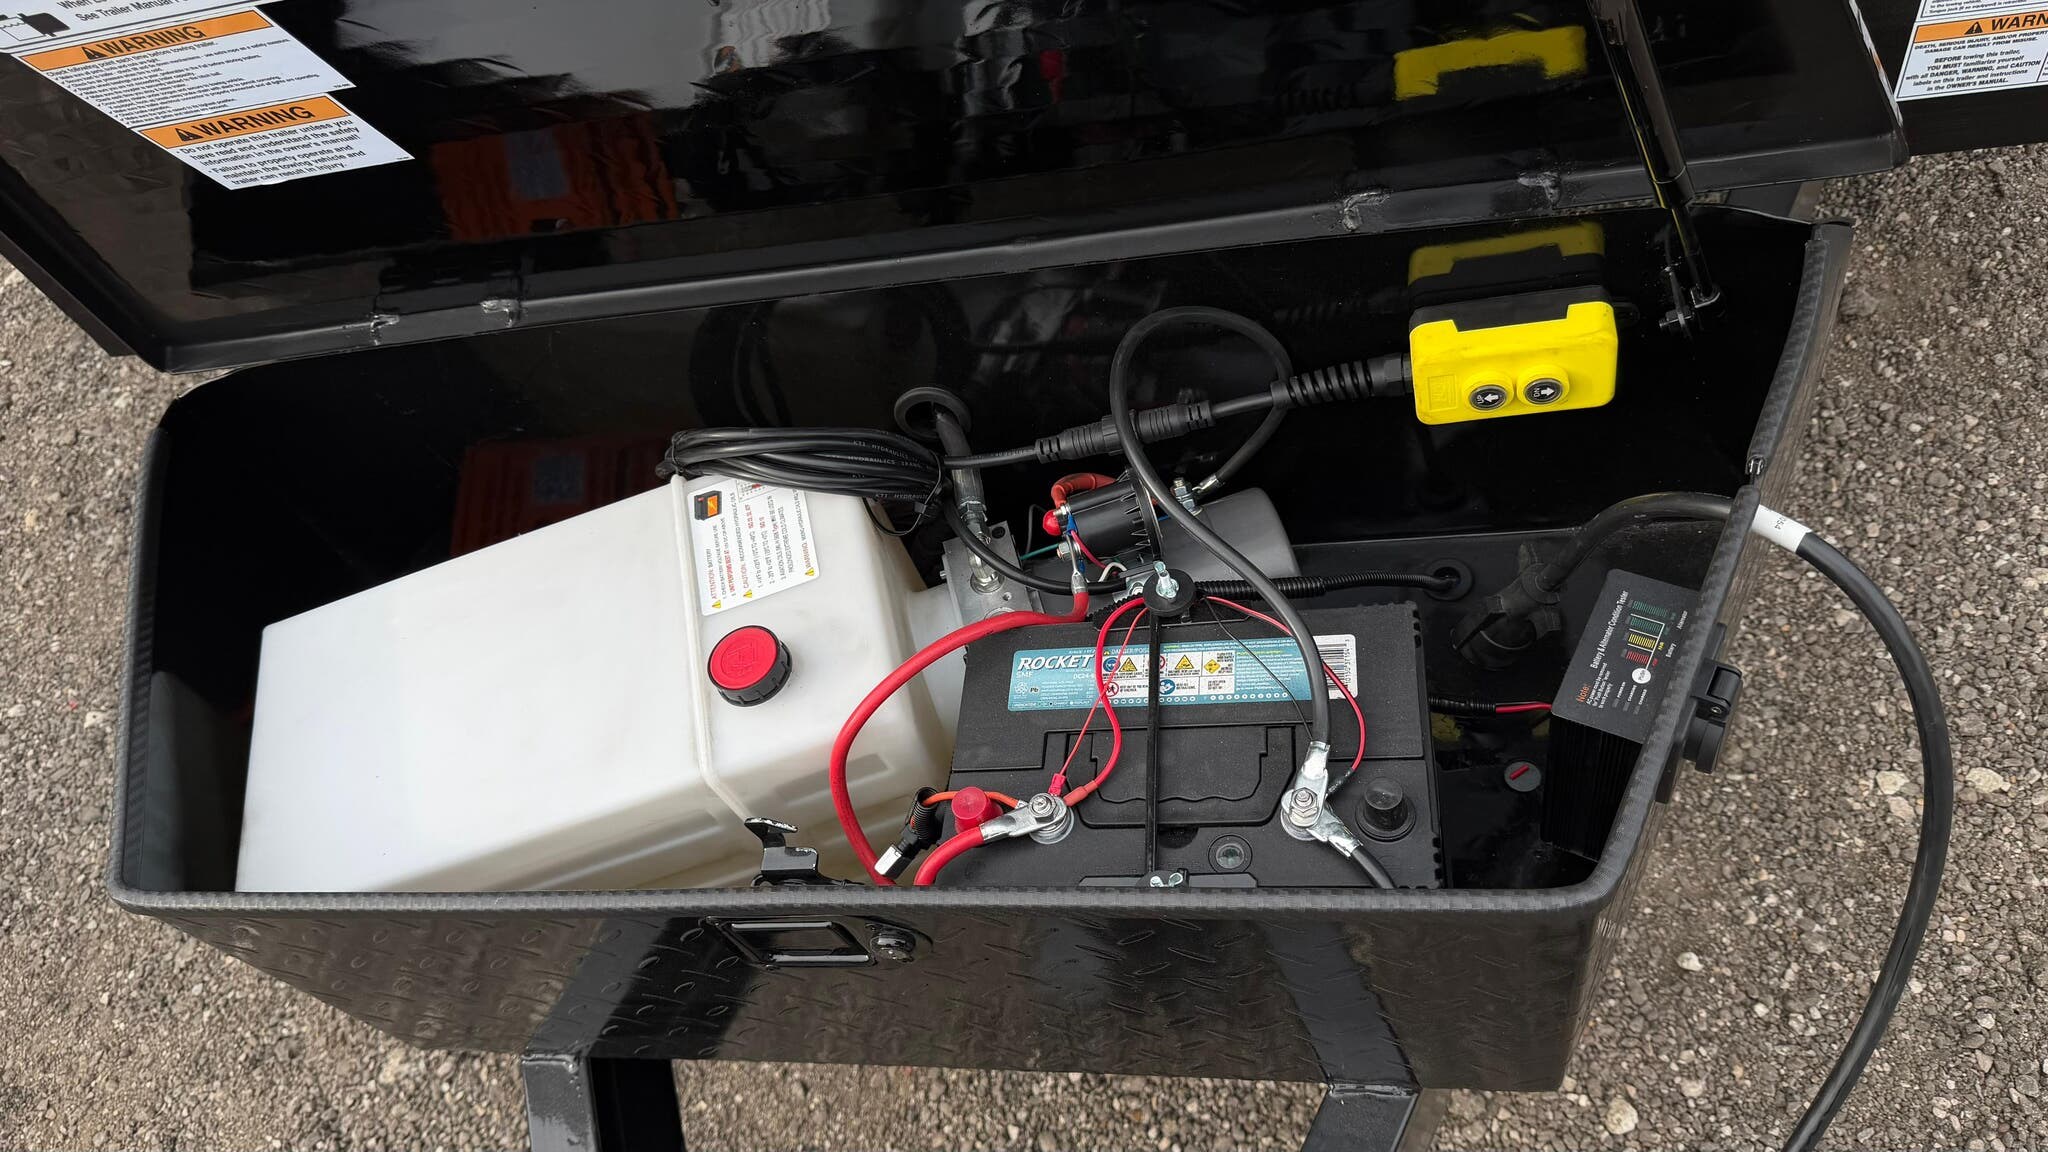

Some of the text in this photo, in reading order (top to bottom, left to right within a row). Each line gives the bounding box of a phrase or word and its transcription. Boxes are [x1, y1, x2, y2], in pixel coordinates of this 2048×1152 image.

[57, 0, 92, 9] When
[75, 0, 173, 21] See Trailer Manual
[96, 26, 206, 55] WARNING
[1997, 55, 2024, 64] yourself
[2010, 60, 2040, 68] CAUTION
[1990, 69, 2028, 77] instructions
[1946, 81, 1976, 89] OWNER'S
[193, 106, 315, 136] WARNING
[214, 139, 250, 148] operate
[299, 124, 333, 132] unless
[333, 120, 353, 128] you
[215, 148, 238, 156] read
[257, 135, 311, 148] understand
[329, 127, 359, 135] safety
[200, 154, 255, 166] information
[283, 142, 321, 151] owner's
[321, 134, 360, 145] manual!
[212, 165, 246, 173] Failure
[257, 156, 297, 166] properly
[297, 149, 334, 158] operate
[223, 170, 263, 179] maintain
[278, 161, 313, 169] towing
[311, 155, 346, 163] vehicle
[231, 177, 259, 185] trailer
[278, 169, 306, 177] result
[1477, 395, 1485, 404] UP
[1533, 388, 1541, 397] DN
[1590, 652, 1605, 668] Battery
[1599, 626, 1614, 648] Alternator
[1608, 605, 1622, 626] Condition
[1617, 591, 1628, 604] Tester
[1665, 643, 1676, 657] Battery
[1018, 655, 1095, 670] ROCKET
